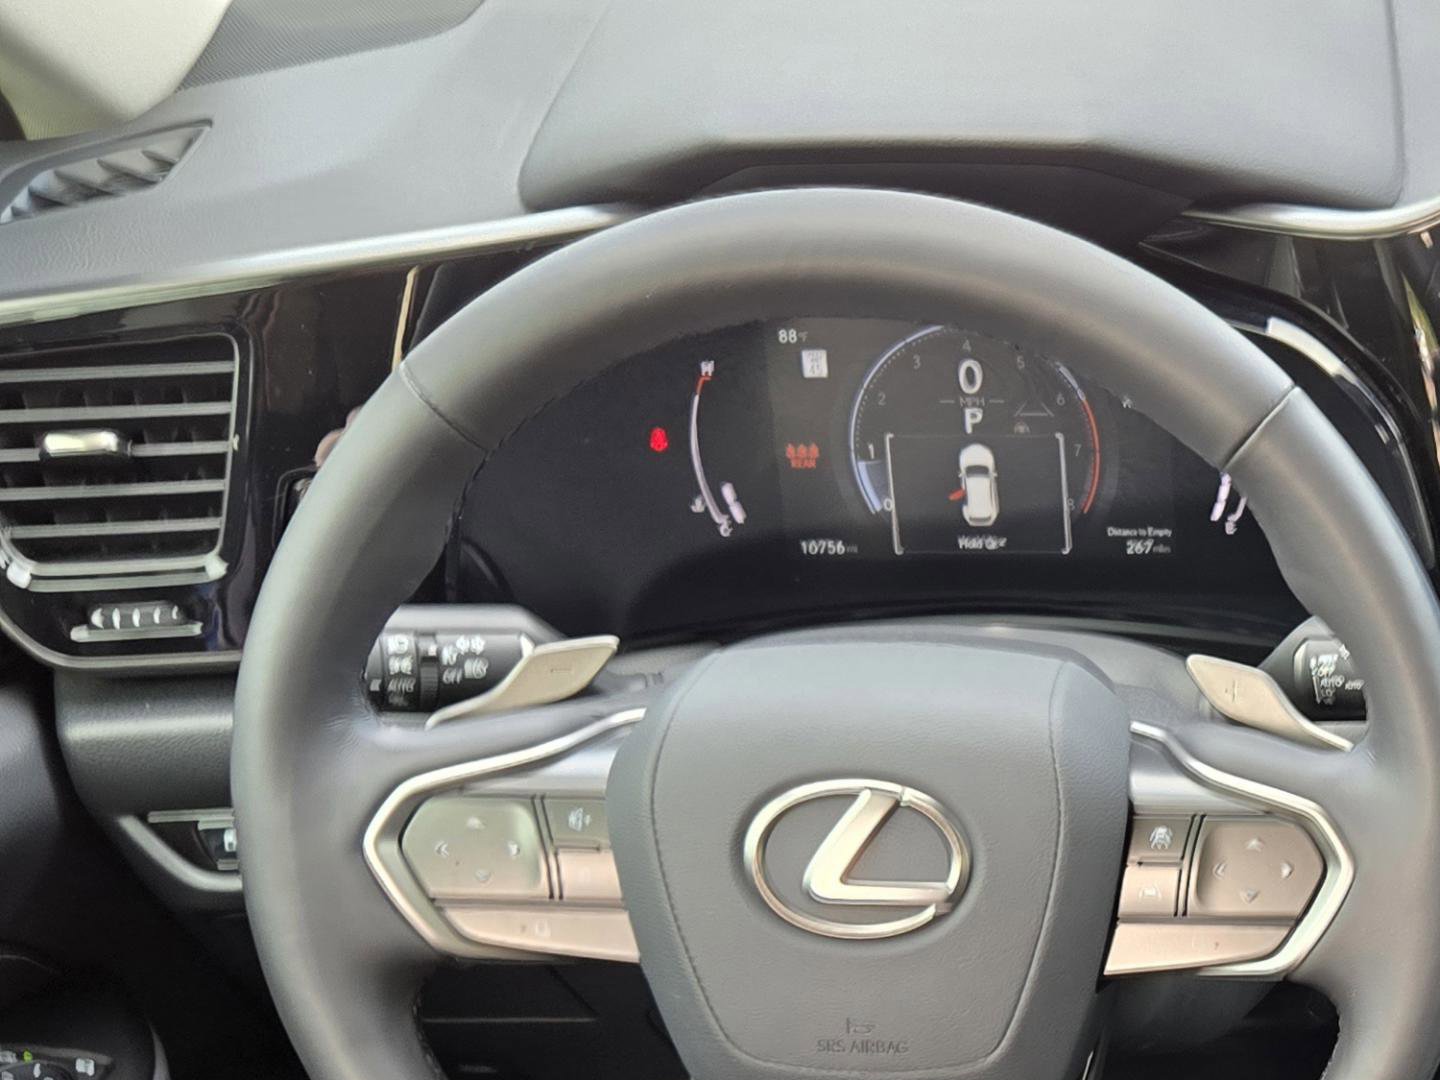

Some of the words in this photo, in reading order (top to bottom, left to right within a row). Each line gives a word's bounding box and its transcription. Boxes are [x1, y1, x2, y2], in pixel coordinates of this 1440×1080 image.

[963, 340, 971, 351] 4
[913, 355, 921, 369] 3
[1016, 356, 1025, 369] 5
[958, 359, 983, 394] 0
[878, 393, 886, 405] 2
[1057, 393, 1065, 405] 6
[964, 407, 984, 434] P
[1073, 444, 1082, 457] 7
[1147, 526, 1172, 538] Empty
[800, 540, 845, 555] 10756
[1126, 538, 1154, 555] 267
[816, 1039, 846, 1053] SRS
[849, 1039, 909, 1054] AIRBAG
